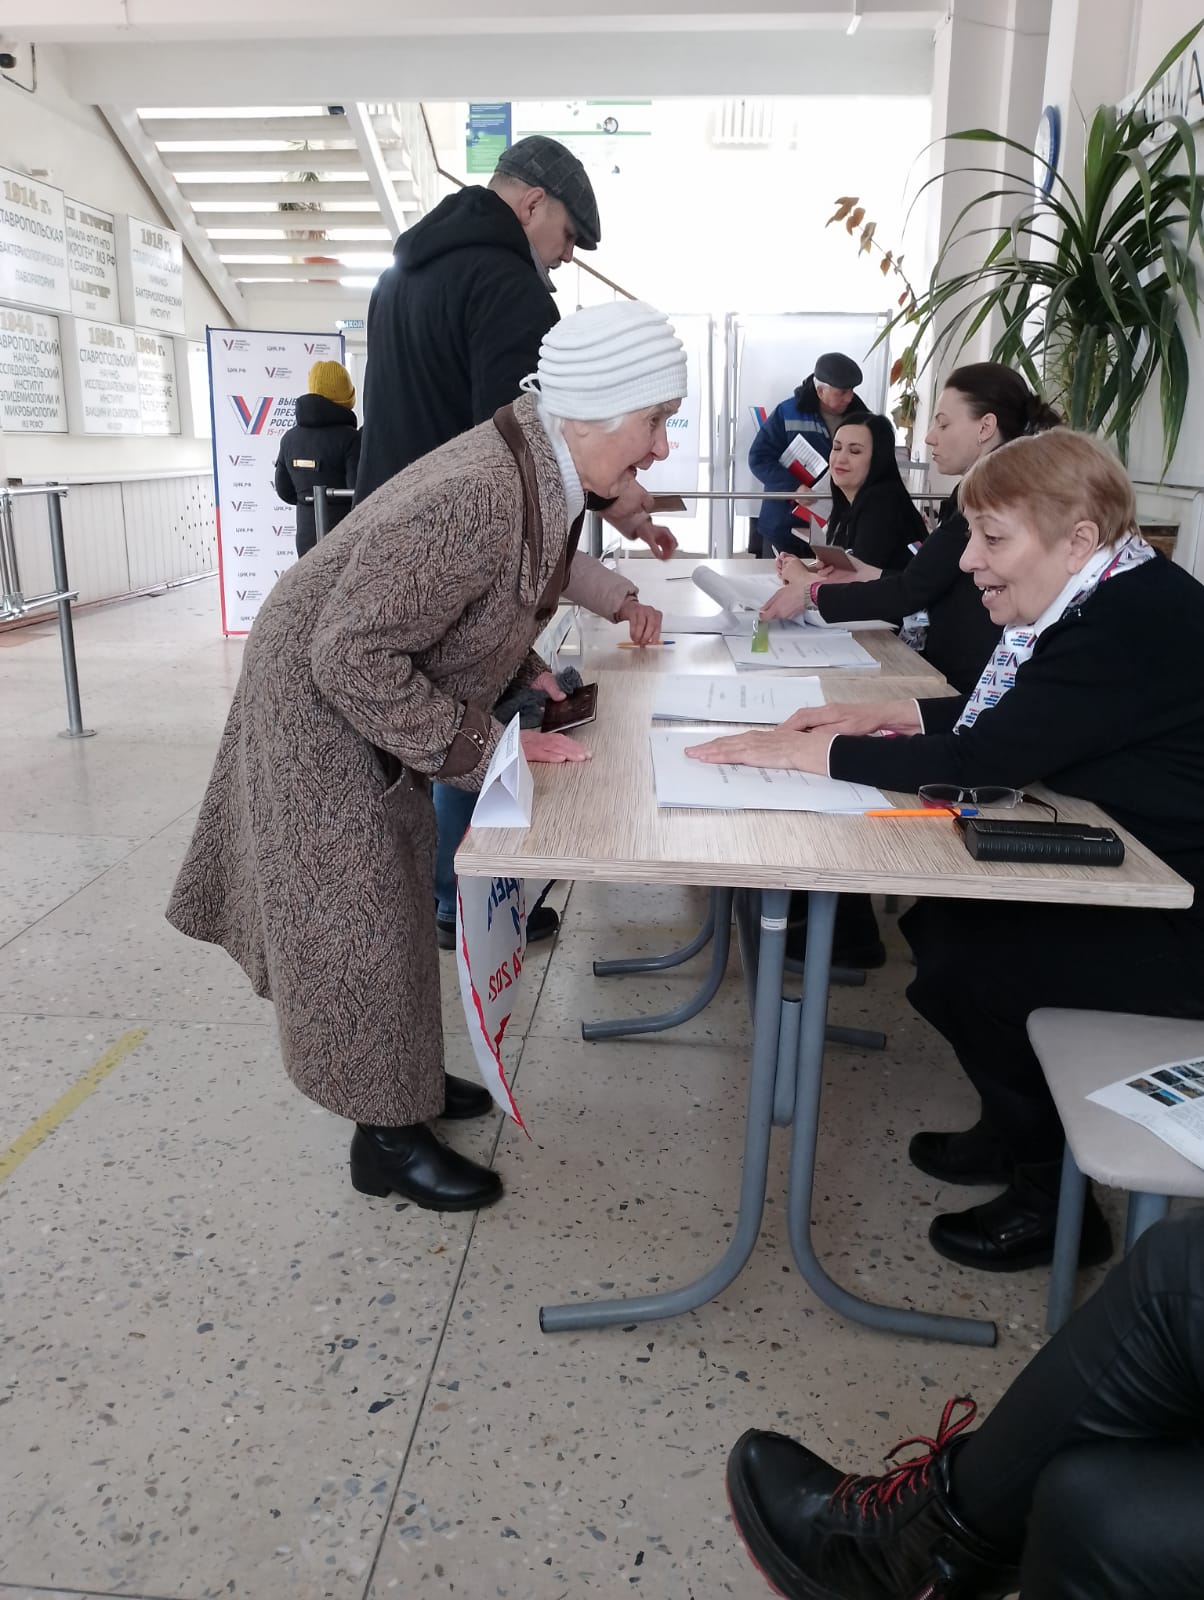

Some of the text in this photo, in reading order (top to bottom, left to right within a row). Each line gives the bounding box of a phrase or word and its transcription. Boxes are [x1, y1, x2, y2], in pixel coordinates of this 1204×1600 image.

[0, 208, 63, 242] ТАВРОПОЛЬСКАЯ
[0, 363, 60, 379] ССЛЕДОВАТЕЛЬСКИЙ
[278, 397, 298, 406] ВЫБ
[274, 408, 296, 417] ПРЕЗ
[667, 418, 689, 428] ЕНТА
